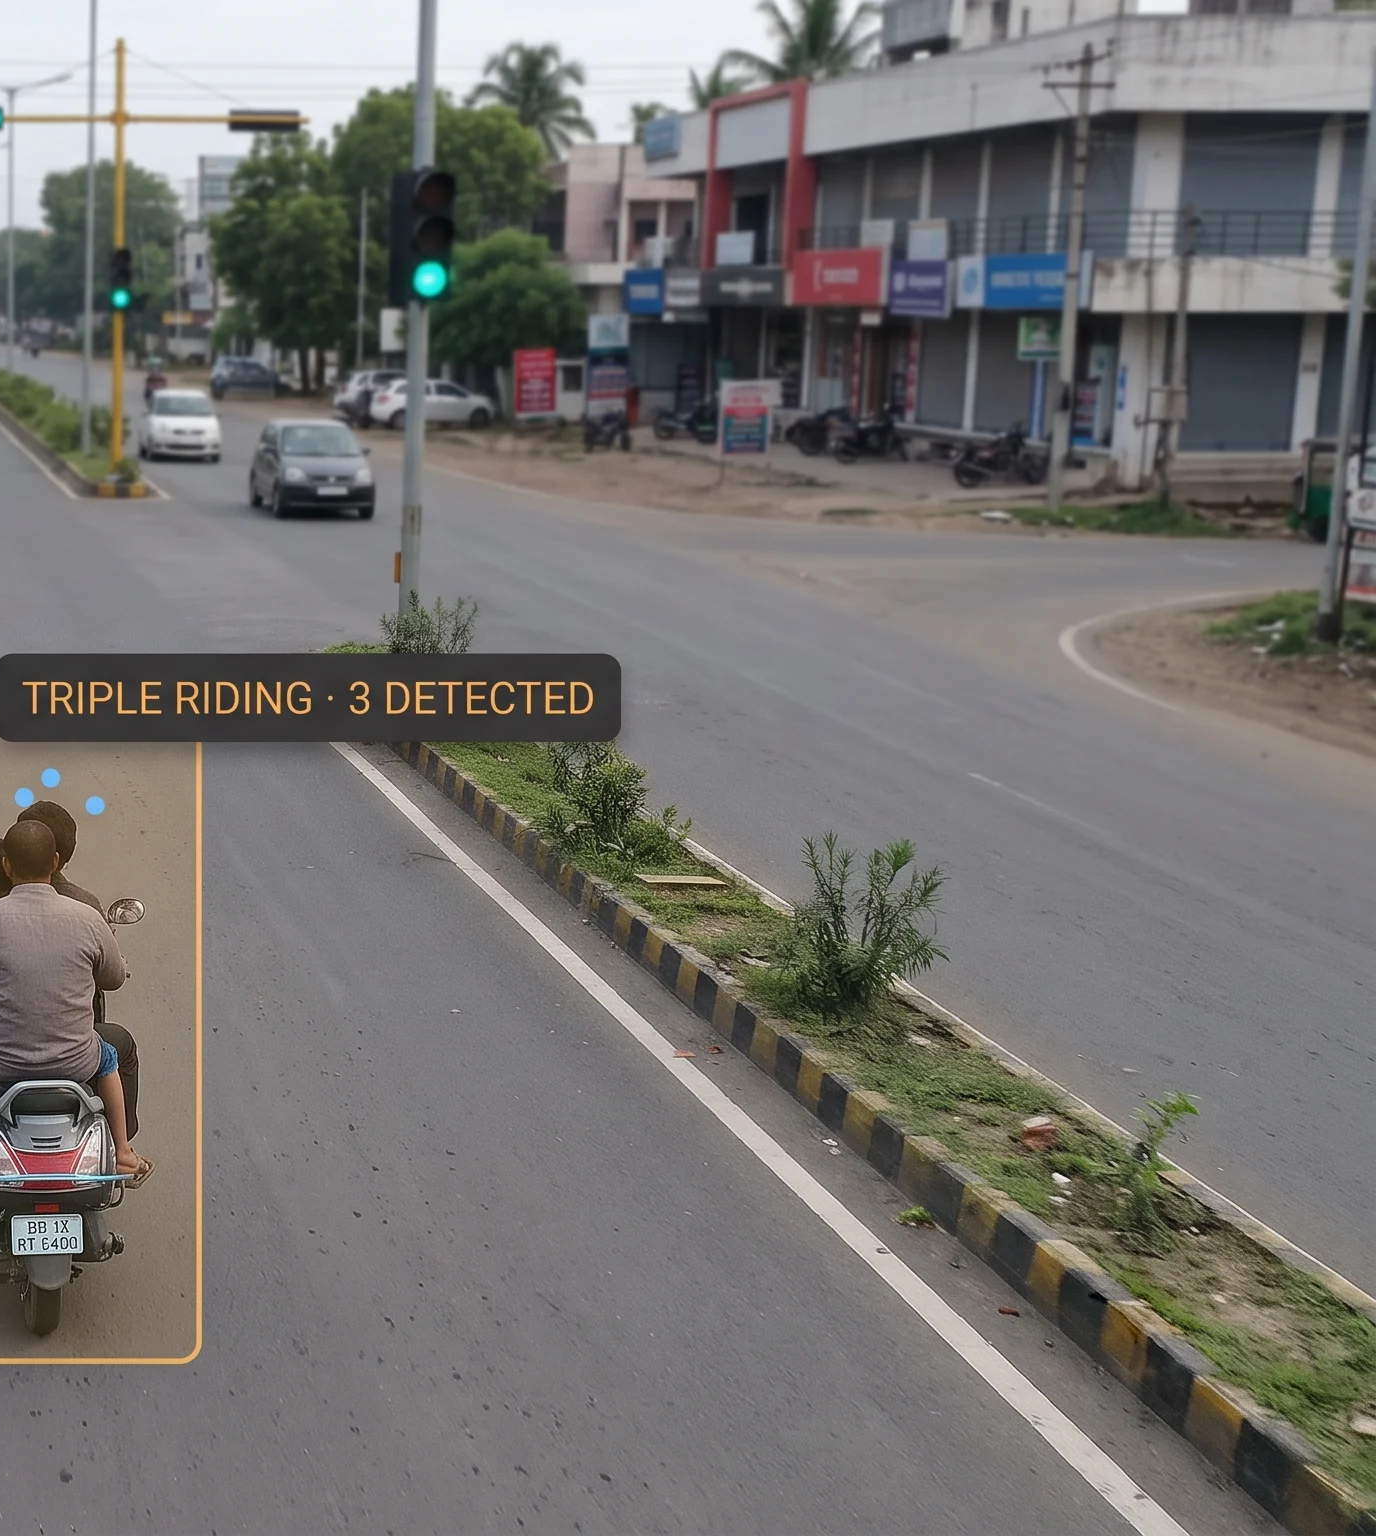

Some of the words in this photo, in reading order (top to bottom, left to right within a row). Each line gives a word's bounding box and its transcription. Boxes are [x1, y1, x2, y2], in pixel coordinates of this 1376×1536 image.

[27, 1221, 47, 1235] BB
[53, 1220, 70, 1234] 1X
[17, 1237, 36, 1252] RT
